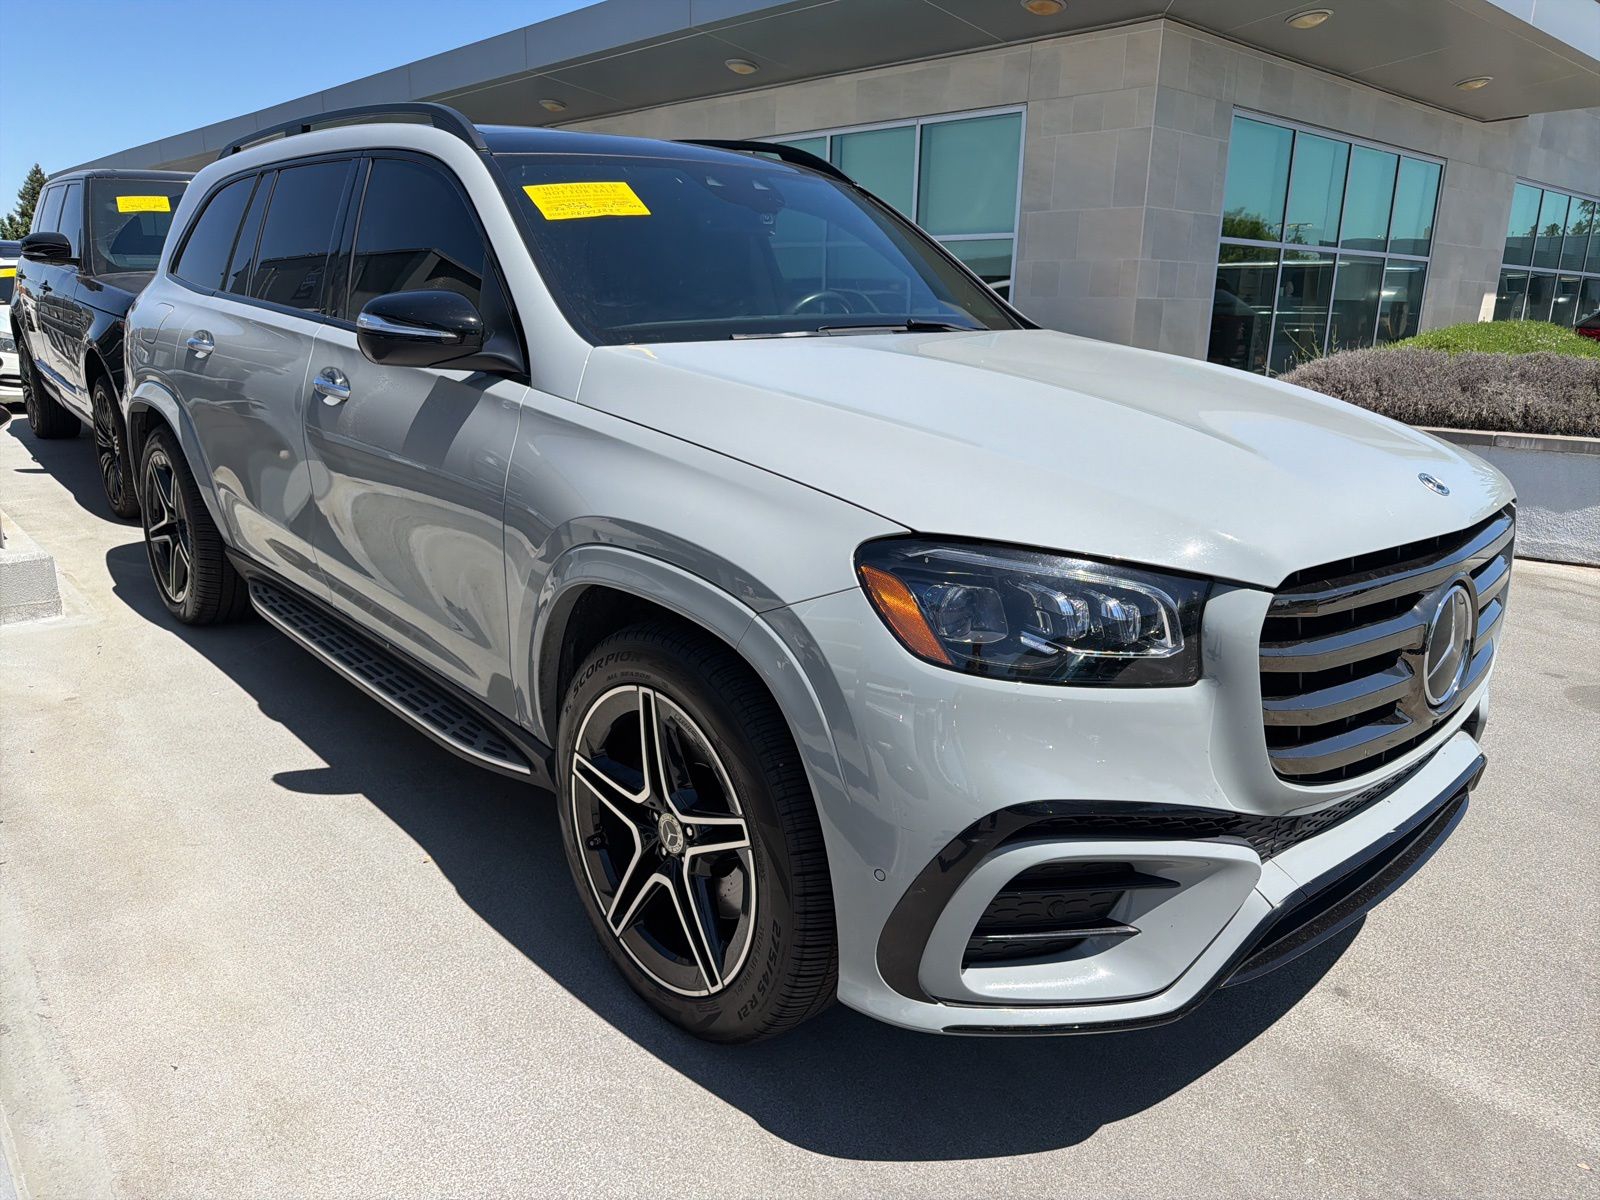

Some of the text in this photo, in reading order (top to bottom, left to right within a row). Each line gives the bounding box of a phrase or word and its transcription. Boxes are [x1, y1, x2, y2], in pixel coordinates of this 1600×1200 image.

[606, 671, 651, 681] ALL SEASON
[757, 920, 781, 995] 275/45
[737, 993, 759, 1021] R21
